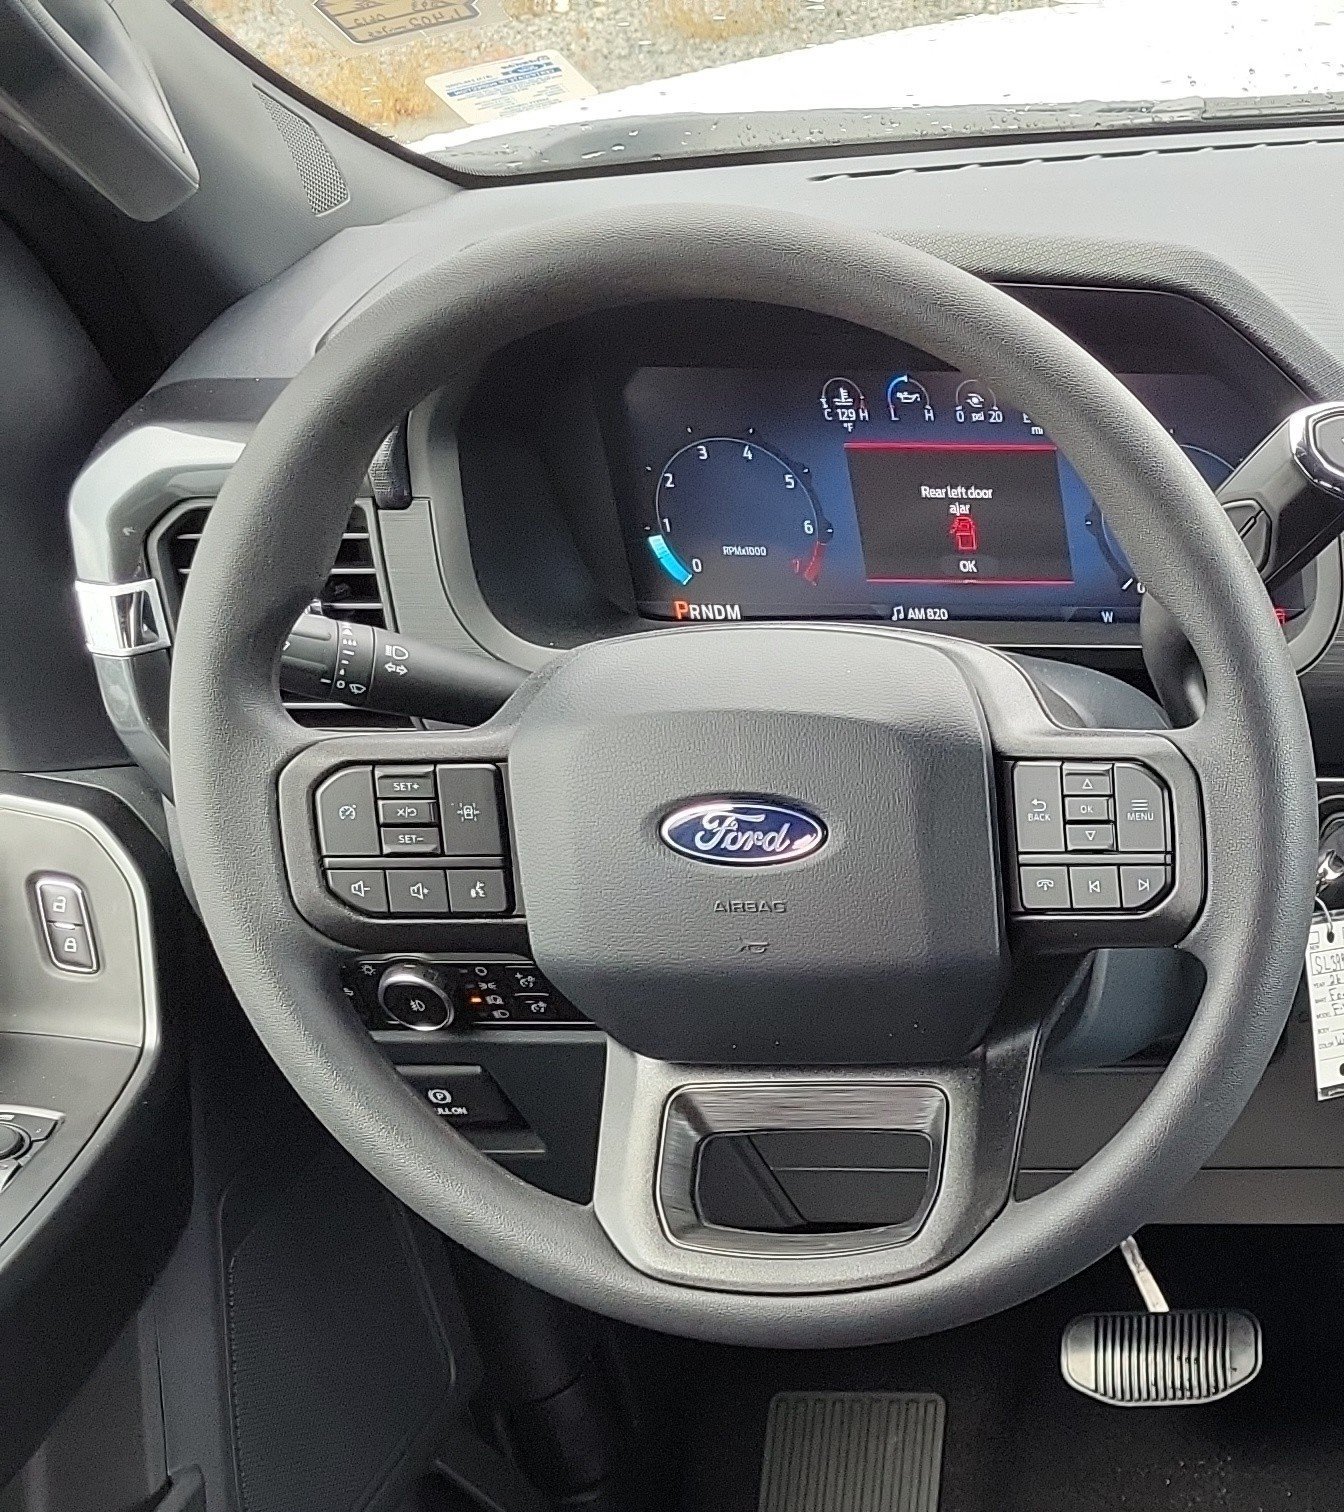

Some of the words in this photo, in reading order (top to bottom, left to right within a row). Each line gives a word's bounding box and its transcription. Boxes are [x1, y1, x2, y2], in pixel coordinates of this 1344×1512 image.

[823, 409, 832, 421] C
[838, 409, 856, 421] 129
[859, 410, 869, 421] H
[924, 410, 935, 422] H
[956, 410, 965, 422] 0
[988, 411, 1003, 423] 20
[697, 445, 708, 460] 3
[743, 445, 753, 460] 4
[663, 473, 675, 488] 2
[784, 474, 795, 489] 5
[921, 486, 946, 499] Rear
[947, 486, 969, 499] left
[968, 487, 993, 500] door
[949, 503, 971, 516] ajar
[663, 518, 671, 533] 1
[803, 520, 814, 534] 6
[723, 546, 767, 557] RPMx1000
[692, 558, 702, 573] 0
[959, 560, 977, 573] OK
[907, 608, 926, 620] AM
[926, 608, 949, 621] 820
[1101, 611, 1114, 623] W
[1080, 804, 1094, 814] OK
[1027, 812, 1051, 823] BACK
[1127, 811, 1154, 822] MENU
[694, 810, 792, 852] Ford
[713, 900, 788, 914] AIRBAG
[452, 1106, 468, 1115] ON
